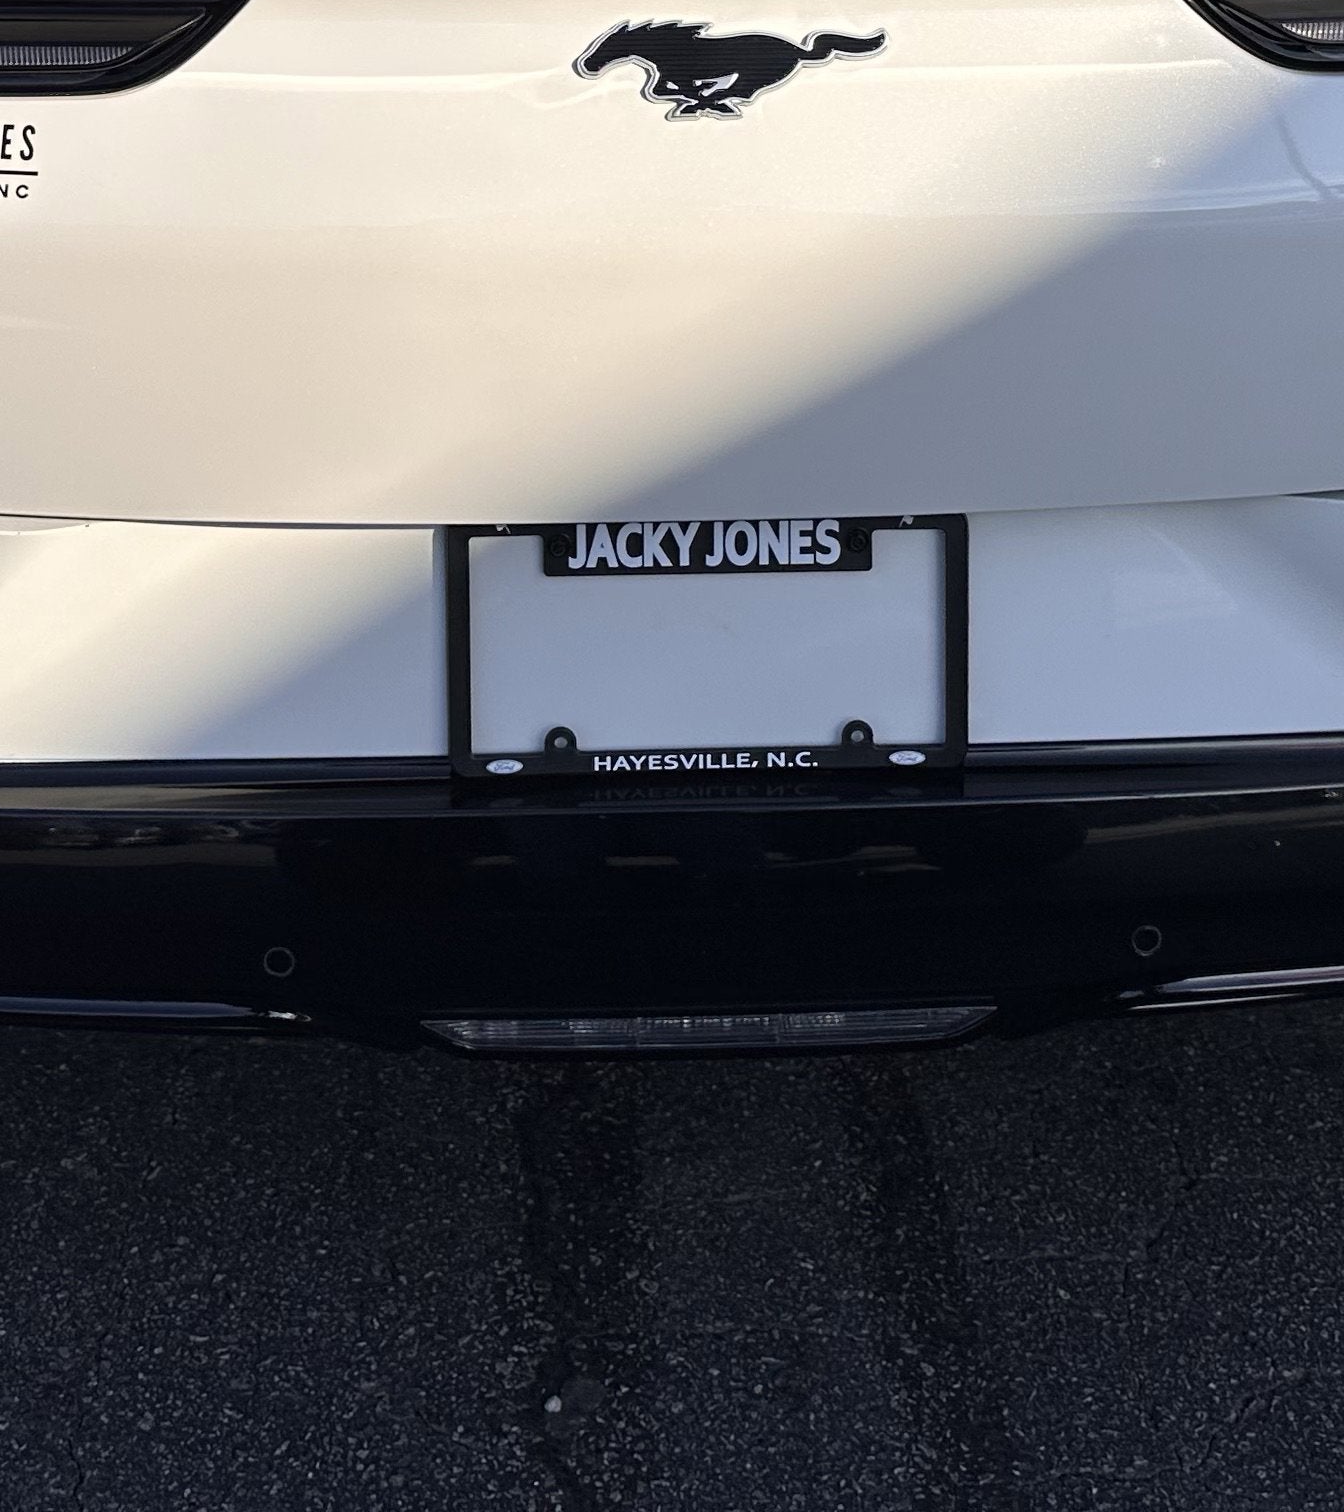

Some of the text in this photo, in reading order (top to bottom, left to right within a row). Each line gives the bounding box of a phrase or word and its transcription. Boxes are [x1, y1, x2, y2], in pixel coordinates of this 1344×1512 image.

[568, 519, 841, 569] JACKY JONES
[593, 751, 818, 772] HAYESVILLE, N.C.
